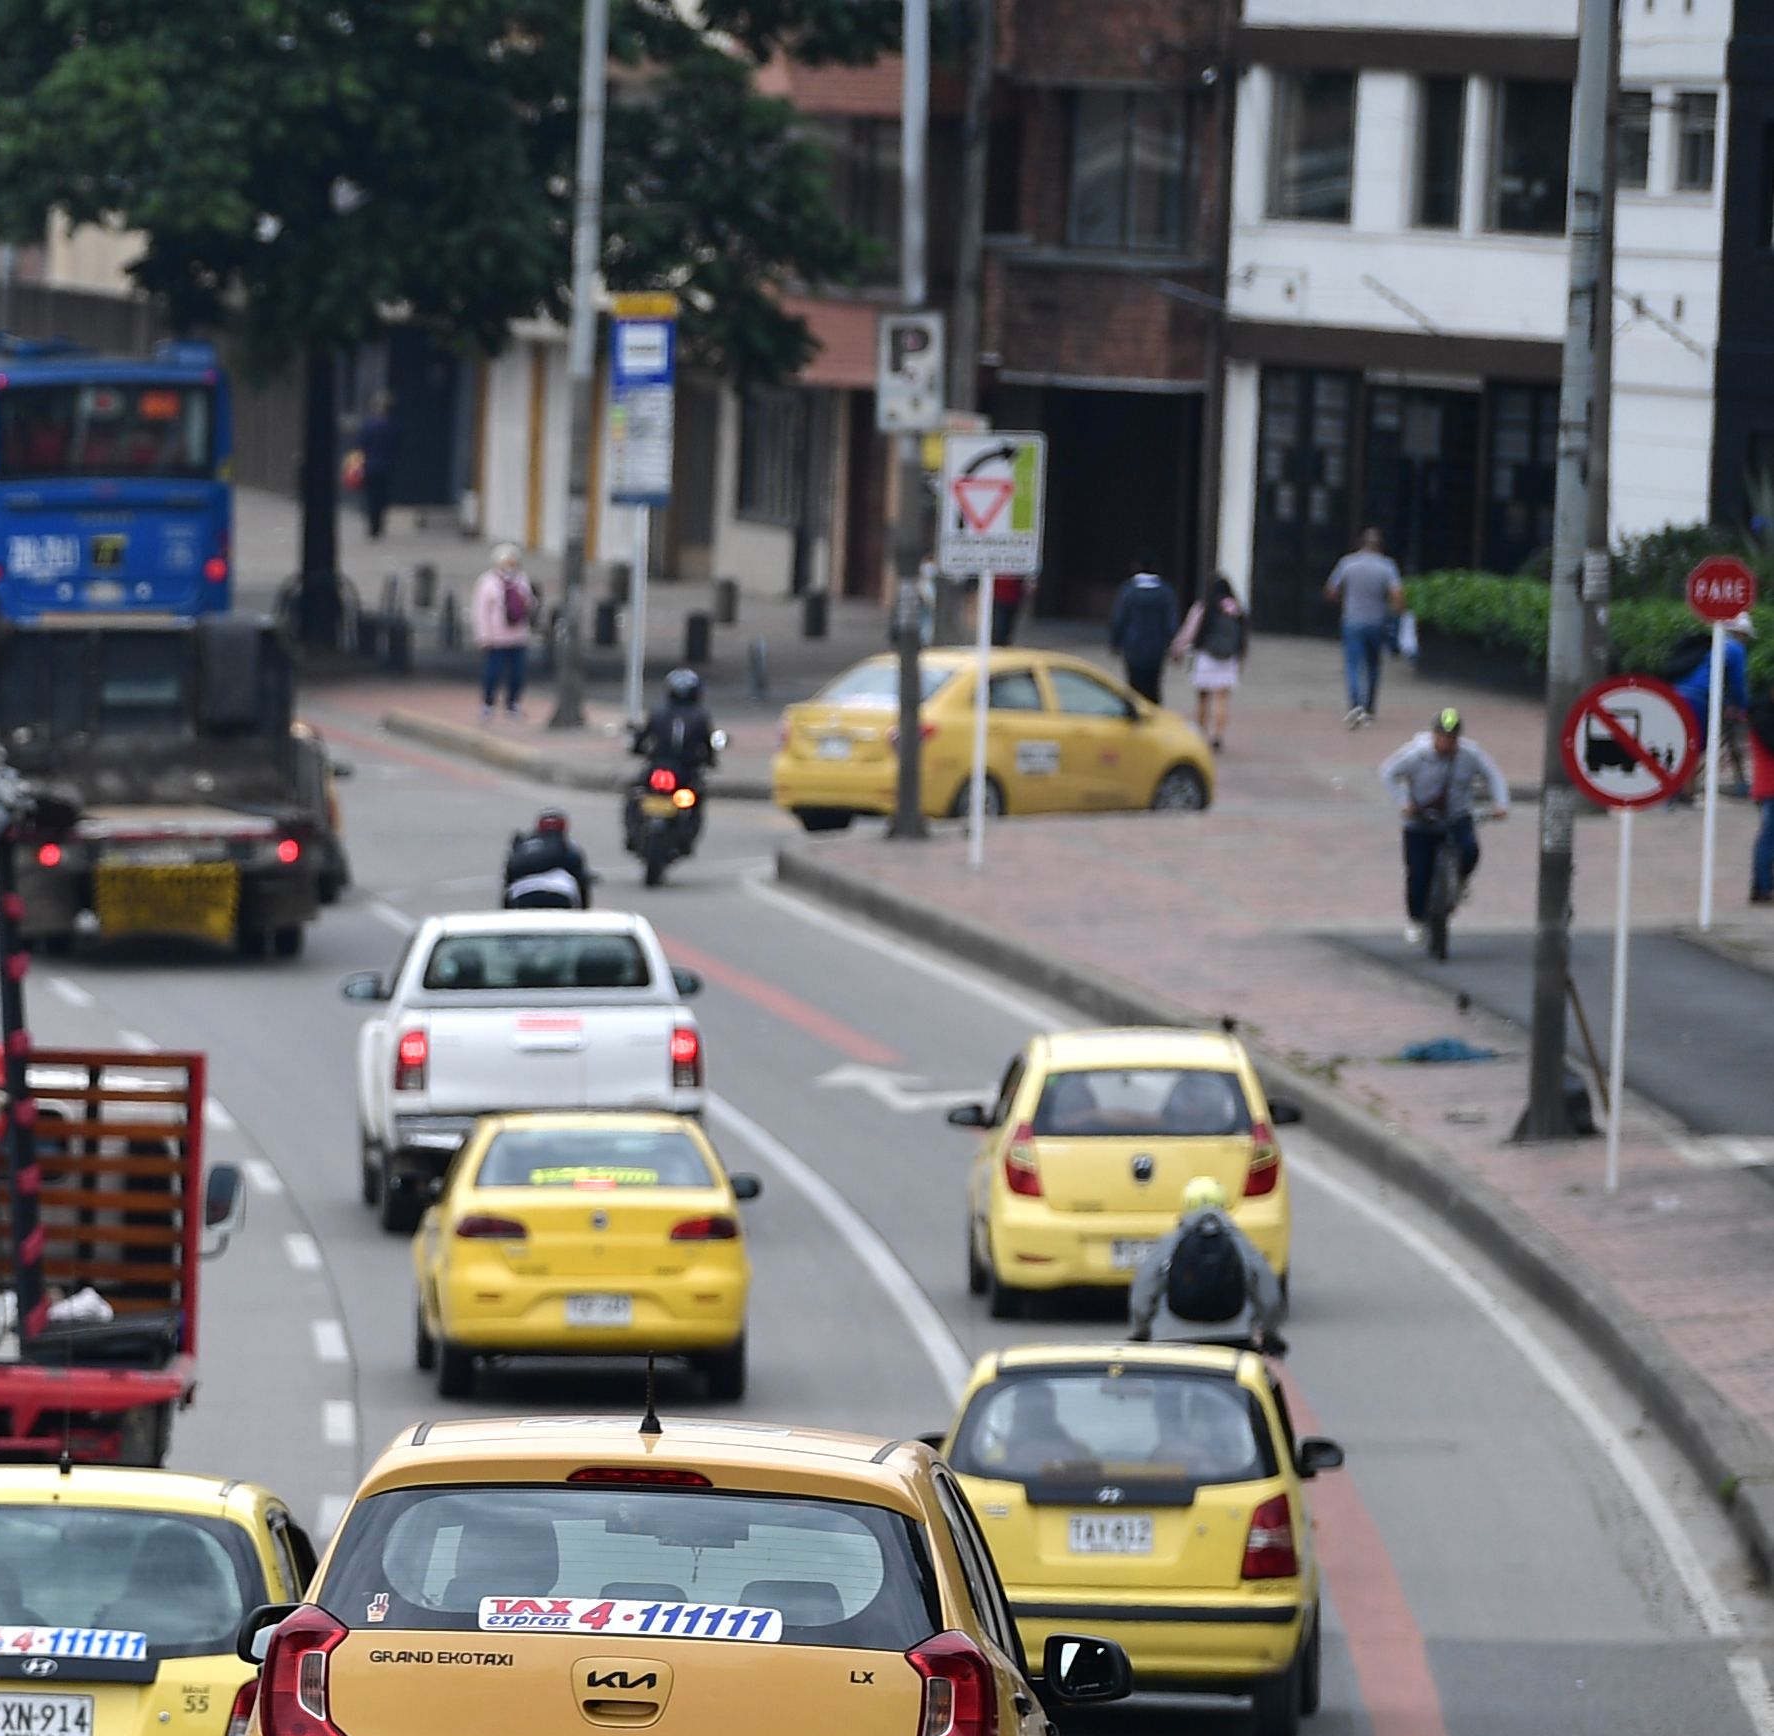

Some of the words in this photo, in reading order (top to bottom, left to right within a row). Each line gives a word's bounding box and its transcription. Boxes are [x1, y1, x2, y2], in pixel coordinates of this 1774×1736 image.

[1695, 576, 1748, 604] PARE
[486, 1613, 569, 1629] express
[369, 1650, 433, 1665] GRAND
[850, 1670, 875, 1685] LX
[183, 1695, 210, 1713] 55
